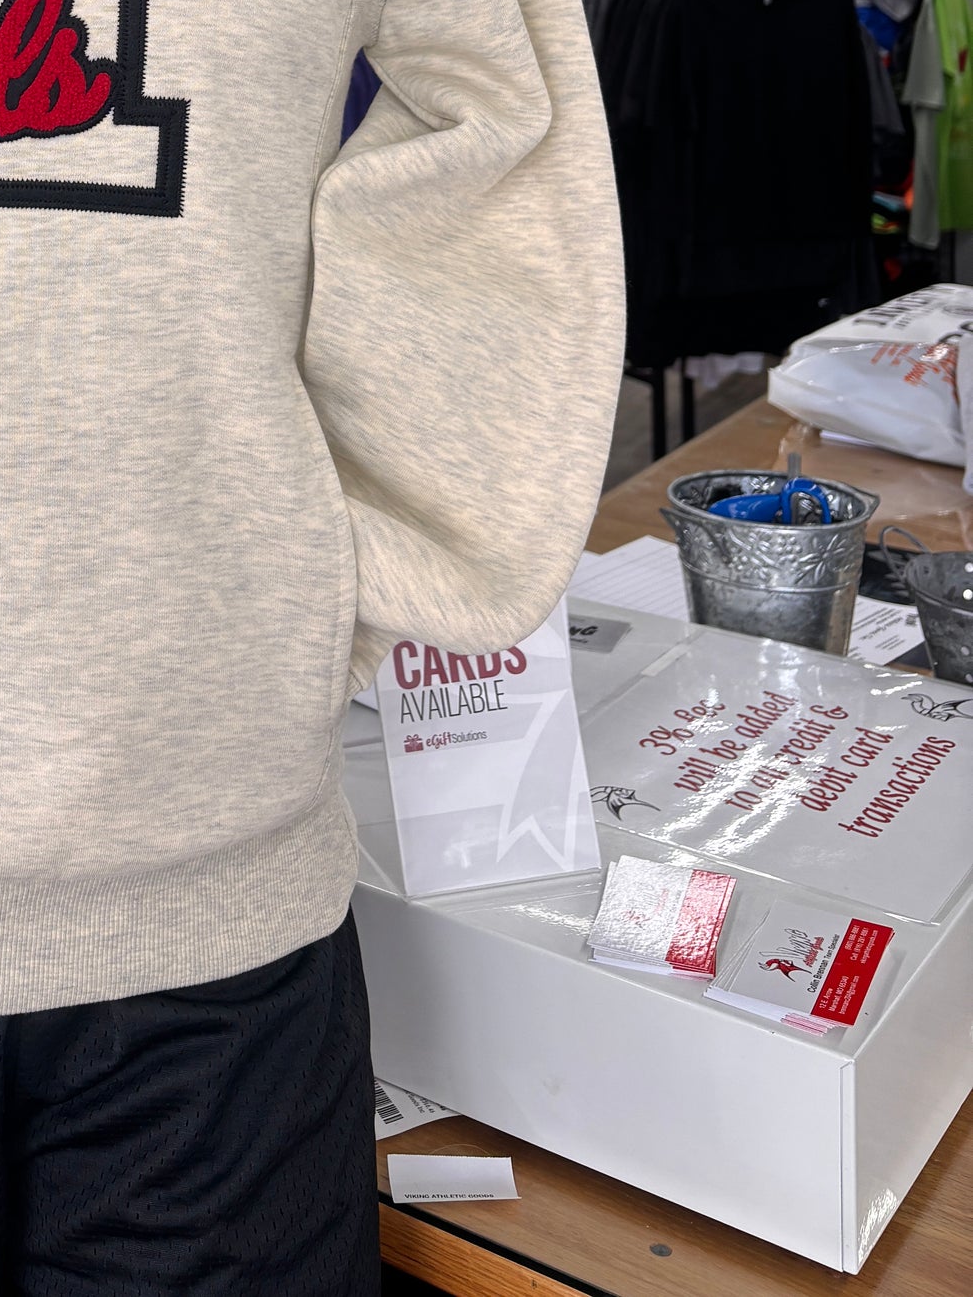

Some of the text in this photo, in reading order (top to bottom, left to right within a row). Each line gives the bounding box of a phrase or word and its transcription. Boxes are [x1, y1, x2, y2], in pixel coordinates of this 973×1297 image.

[400, 679, 508, 724] AVAILABLE
[425, 729, 488, 749] eGiftSolutions
[639, 725, 694, 756] 3%
[673, 690, 796, 793] will be added
[726, 789, 763, 812] to
[775, 717, 835, 766] credit
[808, 705, 849, 720] &
[794, 765, 859, 812] debit
[840, 726, 894, 768] card
[838, 736, 956, 838] transactions
[813, 959, 828, 980] Brennan
[824, 948, 833, 960] Team
[807, 979, 821, 993] Collin
[823, 987, 833, 999] Arrow
